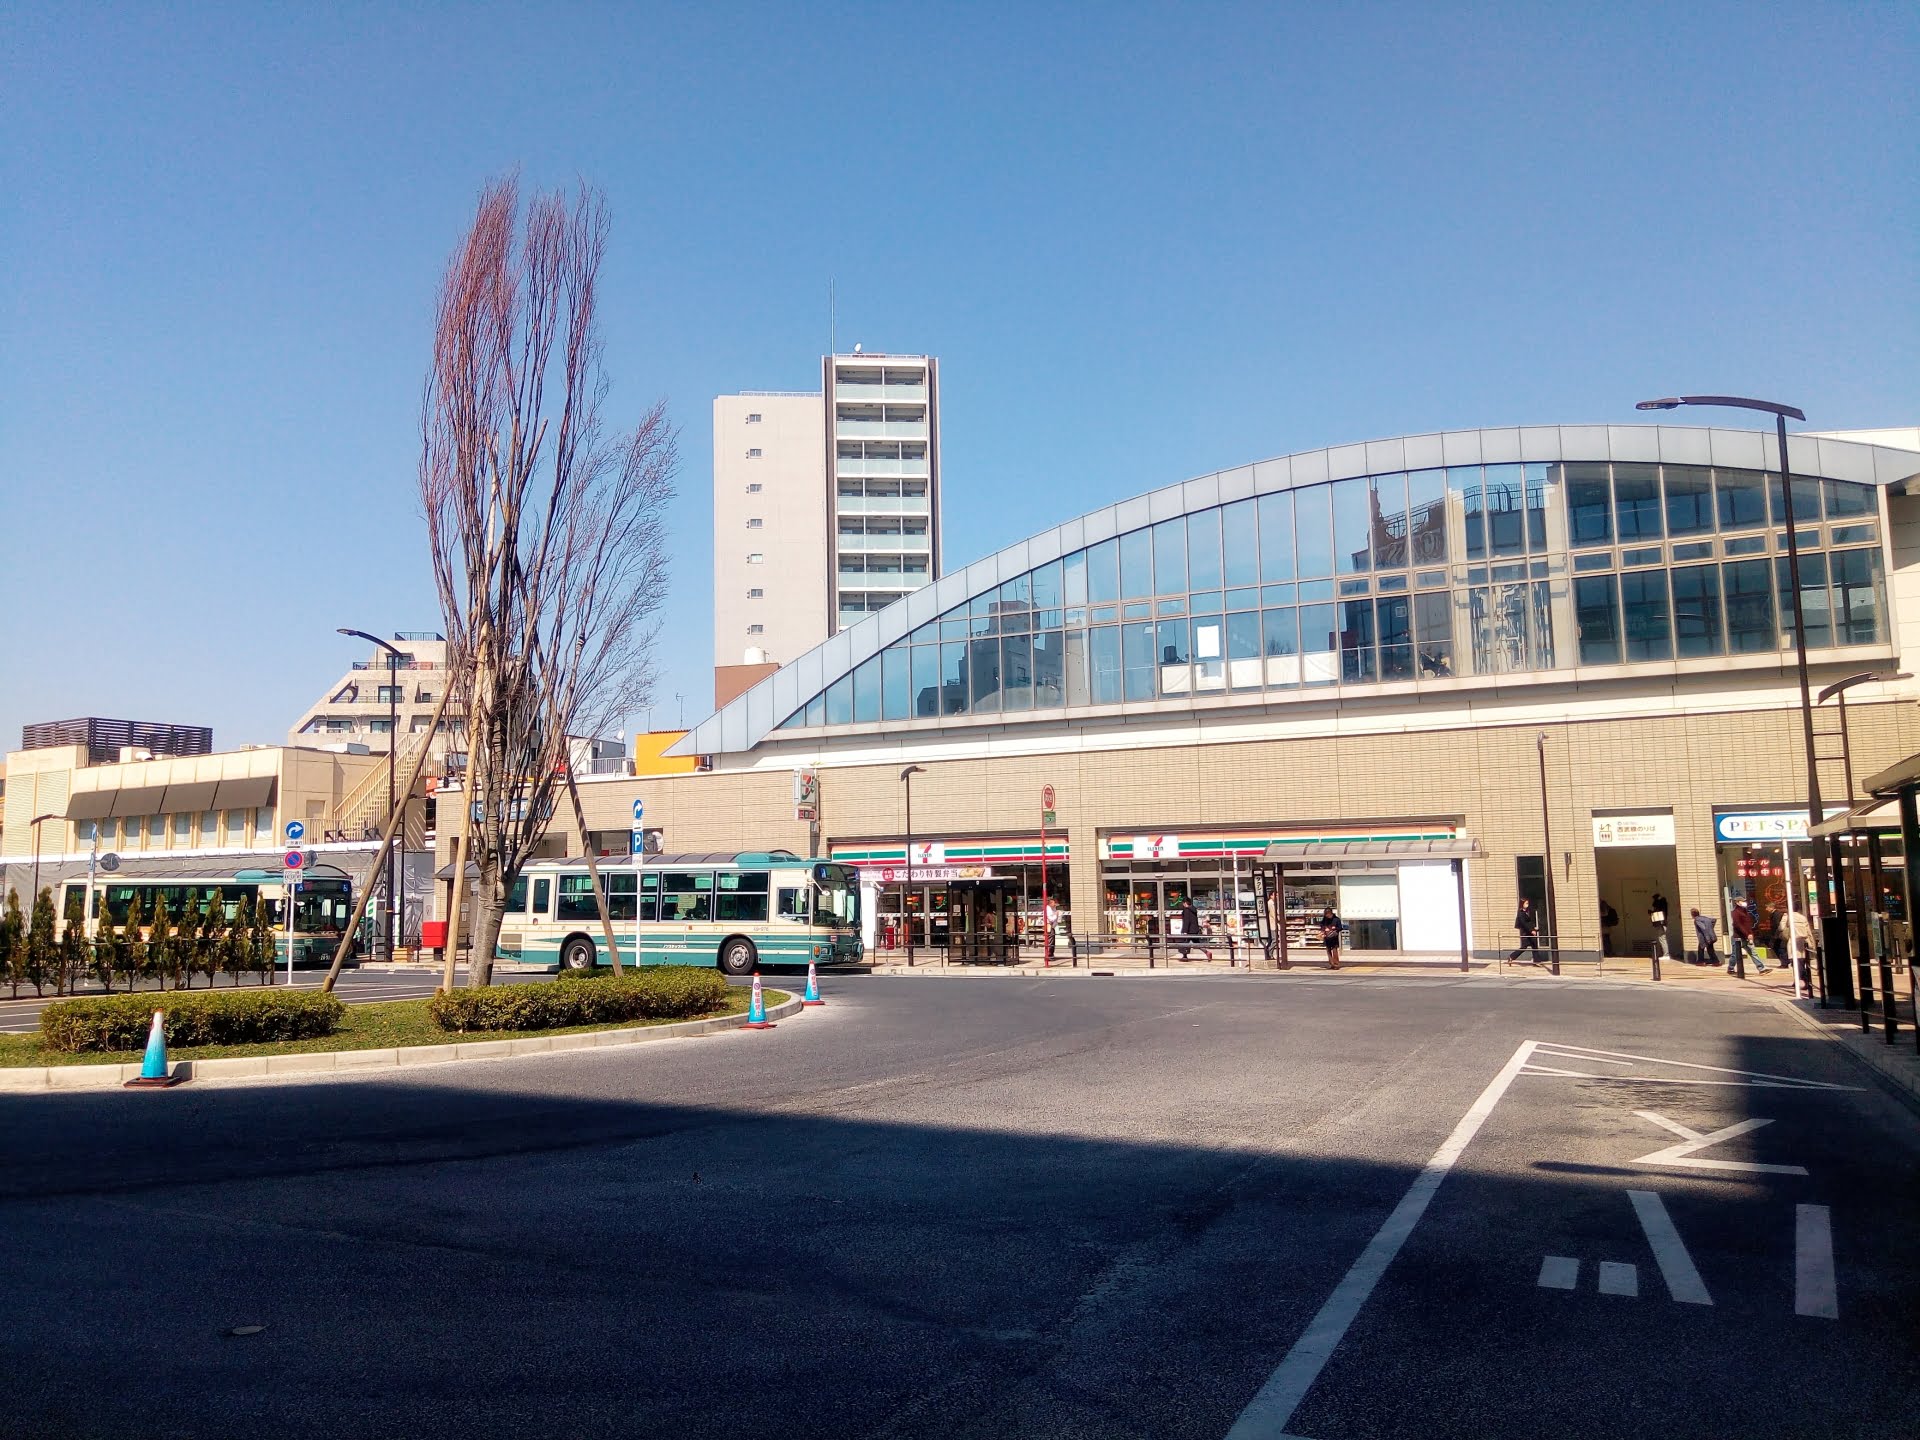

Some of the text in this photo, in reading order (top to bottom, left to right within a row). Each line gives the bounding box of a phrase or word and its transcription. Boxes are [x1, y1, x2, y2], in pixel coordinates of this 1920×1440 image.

[1617, 825, 1656, 833] 西武線のりば
[634, 833, 641, 851] P
[1736, 858, 1770, 866] ホテル
[895, 869, 958, 879] こだわり特製弁当
